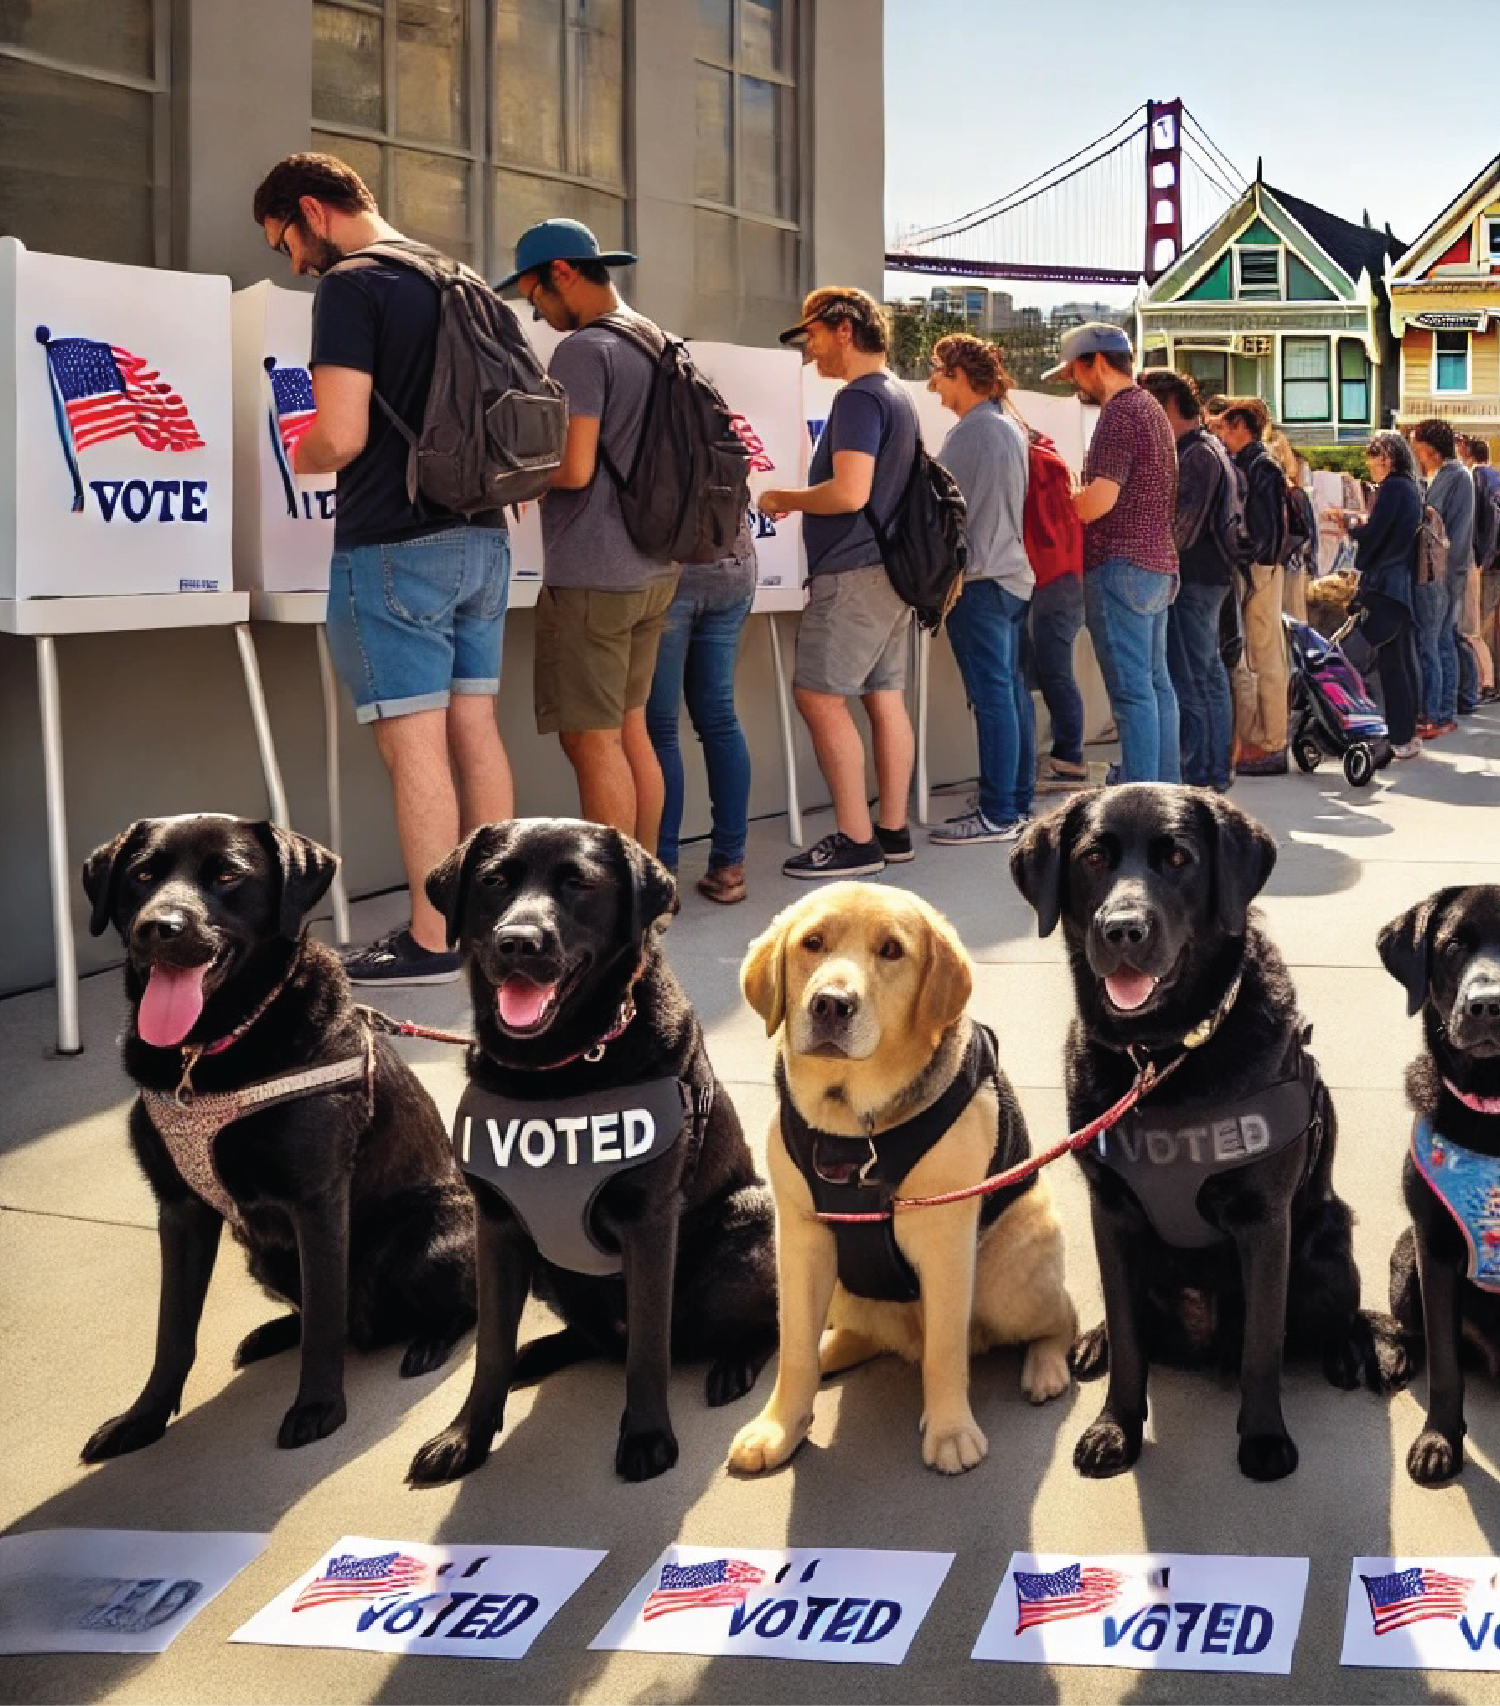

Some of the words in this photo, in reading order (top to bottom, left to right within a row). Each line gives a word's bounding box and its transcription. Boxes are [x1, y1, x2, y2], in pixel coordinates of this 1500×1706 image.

[88, 479, 207, 523] VOTE
[462, 1116, 472, 1163] I
[485, 1108, 655, 1168] VOTED
[356, 1592, 540, 1639] VOTED
[728, 1597, 903, 1645] VOTED
[1102, 1603, 1274, 1656] VOTED
